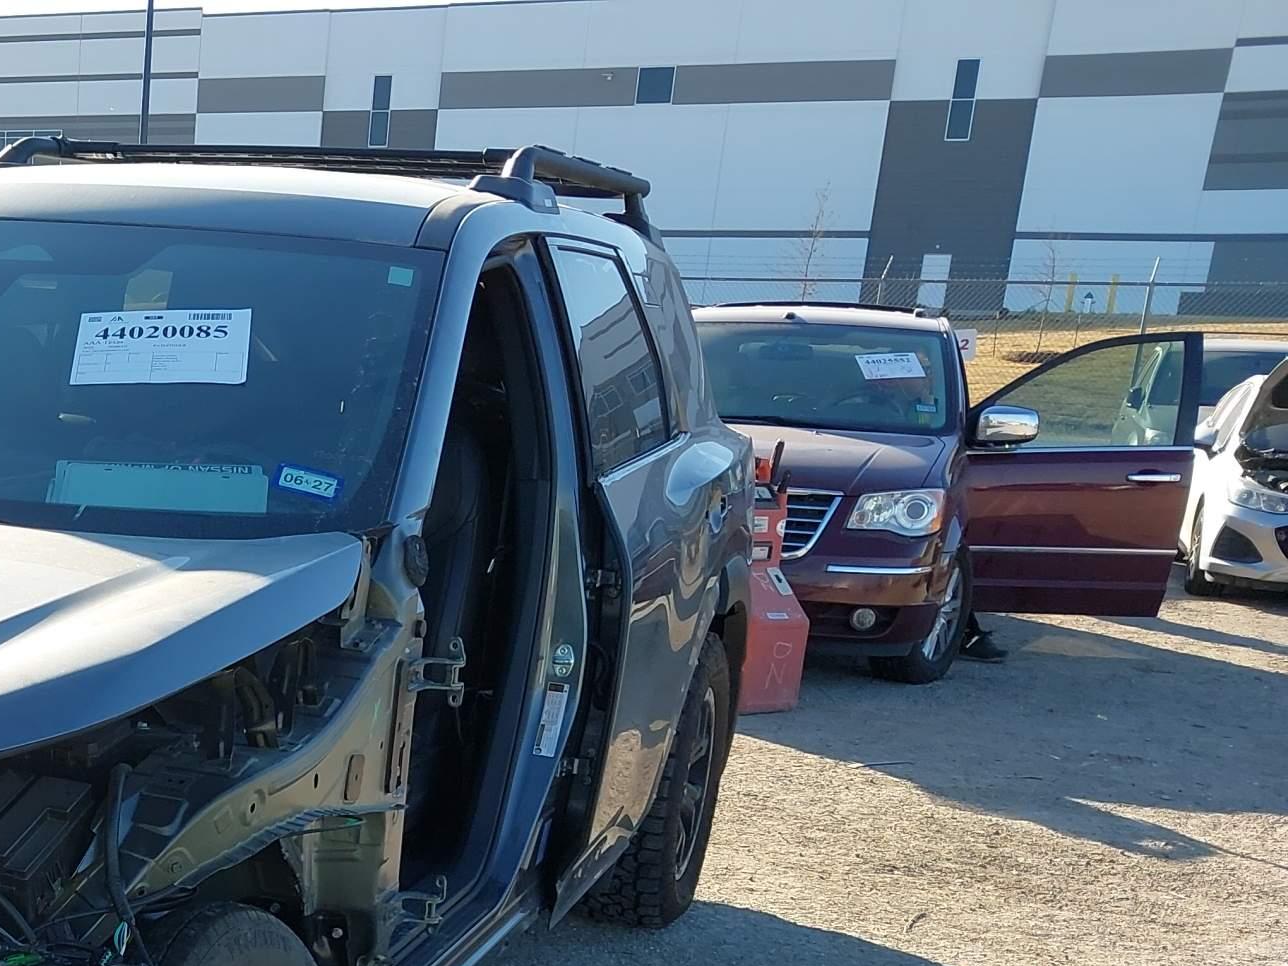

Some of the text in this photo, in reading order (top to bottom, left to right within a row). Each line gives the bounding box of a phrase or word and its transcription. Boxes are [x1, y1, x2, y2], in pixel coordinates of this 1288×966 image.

[94, 324, 229, 340] 44020085
[960, 338, 970, 350] 2
[283, 472, 334, 492] 06 27
